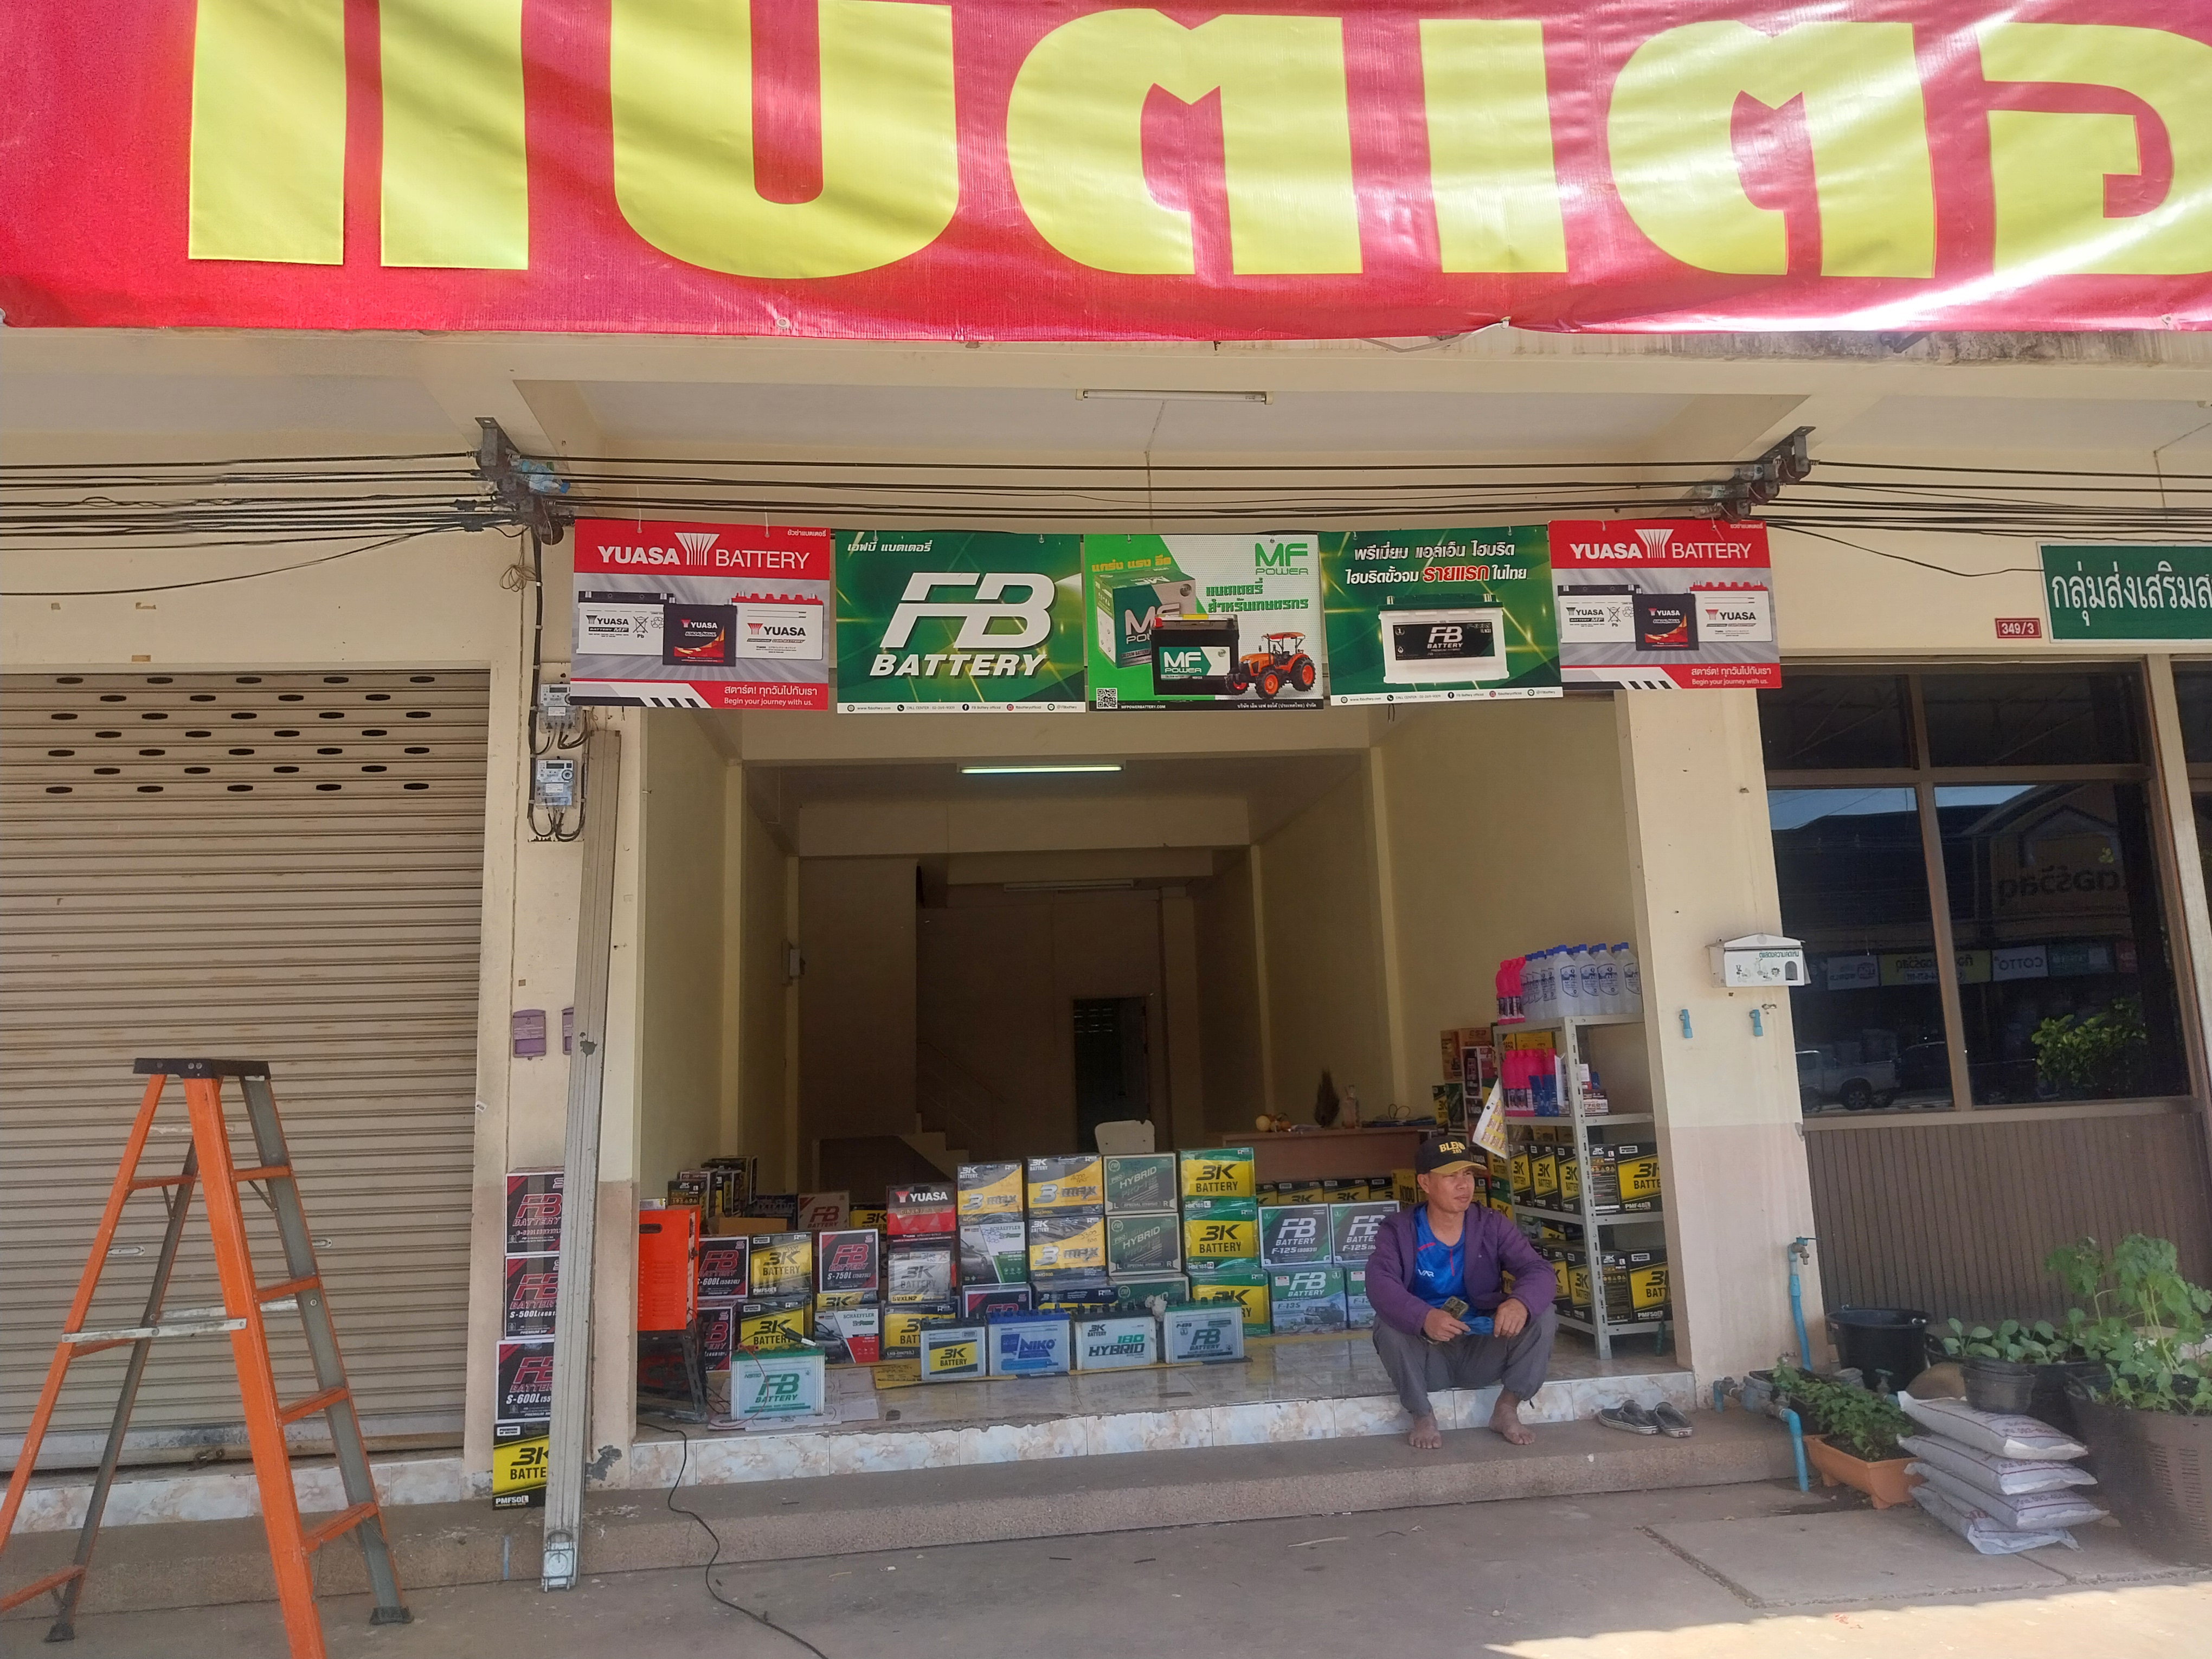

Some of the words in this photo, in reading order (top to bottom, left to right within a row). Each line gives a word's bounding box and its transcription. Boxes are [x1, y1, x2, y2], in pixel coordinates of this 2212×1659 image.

[847, 541, 877, 552] เอฟบี
[882, 540, 933, 552] แบตเตอรี่
[1415, 542, 1466, 558] แอลเอ็น
[1472, 541, 1515, 556] ไฮบริด
[1570, 543, 1642, 558] YUASA
[1672, 542, 1751, 558] BATTERY
[597, 545, 680, 565] YUASA
[716, 549, 809, 569] BATTERY
[1255, 543, 1308, 567] MF
[1128, 558, 1151, 568] แรง
[1345, 565, 1419, 584] ไฮบริดขั้วจม
[1423, 565, 1490, 583] รายแรก
[1493, 565, 1527, 580] ในไทย
[1206, 578, 1263, 596] แบตเตอรี่
[2052, 561, 2212, 627] กลุ่มส่งเสริมส
[880, 573, 1055, 648] FB
[1208, 599, 1309, 613] สำหรับเกษตรกร
[1719, 612, 1756, 620] YUASA
[763, 627, 806, 636] YUASA
[1429, 627, 1463, 643] FB
[2002, 623, 2035, 634] 349/3
[870, 654, 1047, 676] BATTERY
[1164, 652, 1201, 667] MF
[1692, 666, 1719, 676] สตาร์ต!
[1721, 666, 1771, 677] ทุกวันไปกับเรา
[724, 685, 756, 696] สตาร์ต!
[760, 686, 818, 697] ทุกวันไปกับเรา
[724, 698, 741, 706] Begin
[761, 699, 786, 708] journey
[1195, 1164, 1237, 1181] 3K
[1513, 1161, 1523, 1174] 3K
[1538, 1163, 1551, 1177] 3K
[1565, 1166, 1578, 1181] 3K
[1119, 1166, 1157, 1189] HYBRID
[1538, 1177, 1552, 1188] BATTERY
[1196, 1181, 1238, 1192] BATTERY
[910, 1192, 948, 1203] YUASA
[1337, 1192, 1359, 1201] 3K
[516, 1193, 563, 1219] FB
[513, 1217, 561, 1226] BATTERY
[809, 1206, 840, 1223] FB
[1199, 1224, 1240, 1242] 3K
[1278, 1218, 1316, 1239] FB
[1123, 1226, 1160, 1249] HYBRID
[1276, 1238, 1315, 1246] BATTERY
[833, 1244, 869, 1265] FB
[1199, 1242, 1241, 1253] BATTERY
[700, 1250, 739, 1271] FB
[763, 1251, 801, 1266] 3K
[763, 1265, 800, 1276] BATTERY
[828, 1263, 868, 1271] BATTERY
[901, 1265, 937, 1278] 3K
[901, 1279, 936, 1288] BATTERY
[1290, 1272, 1326, 1290] FB
[1575, 1272, 1589, 1289] 3K
[754, 1320, 793, 1335] 3K
[1117, 1334, 1144, 1343] 180
[1192, 1328, 1221, 1345] FB
[1020, 1338, 1056, 1351] NIKO
[1089, 1343, 1145, 1356] HYBRID
[941, 1348, 967, 1359] 3K
[758, 1373, 800, 1396] FB
[755, 1394, 798, 1403] BATTERY
[510, 1467, 546, 1480] BATTE
